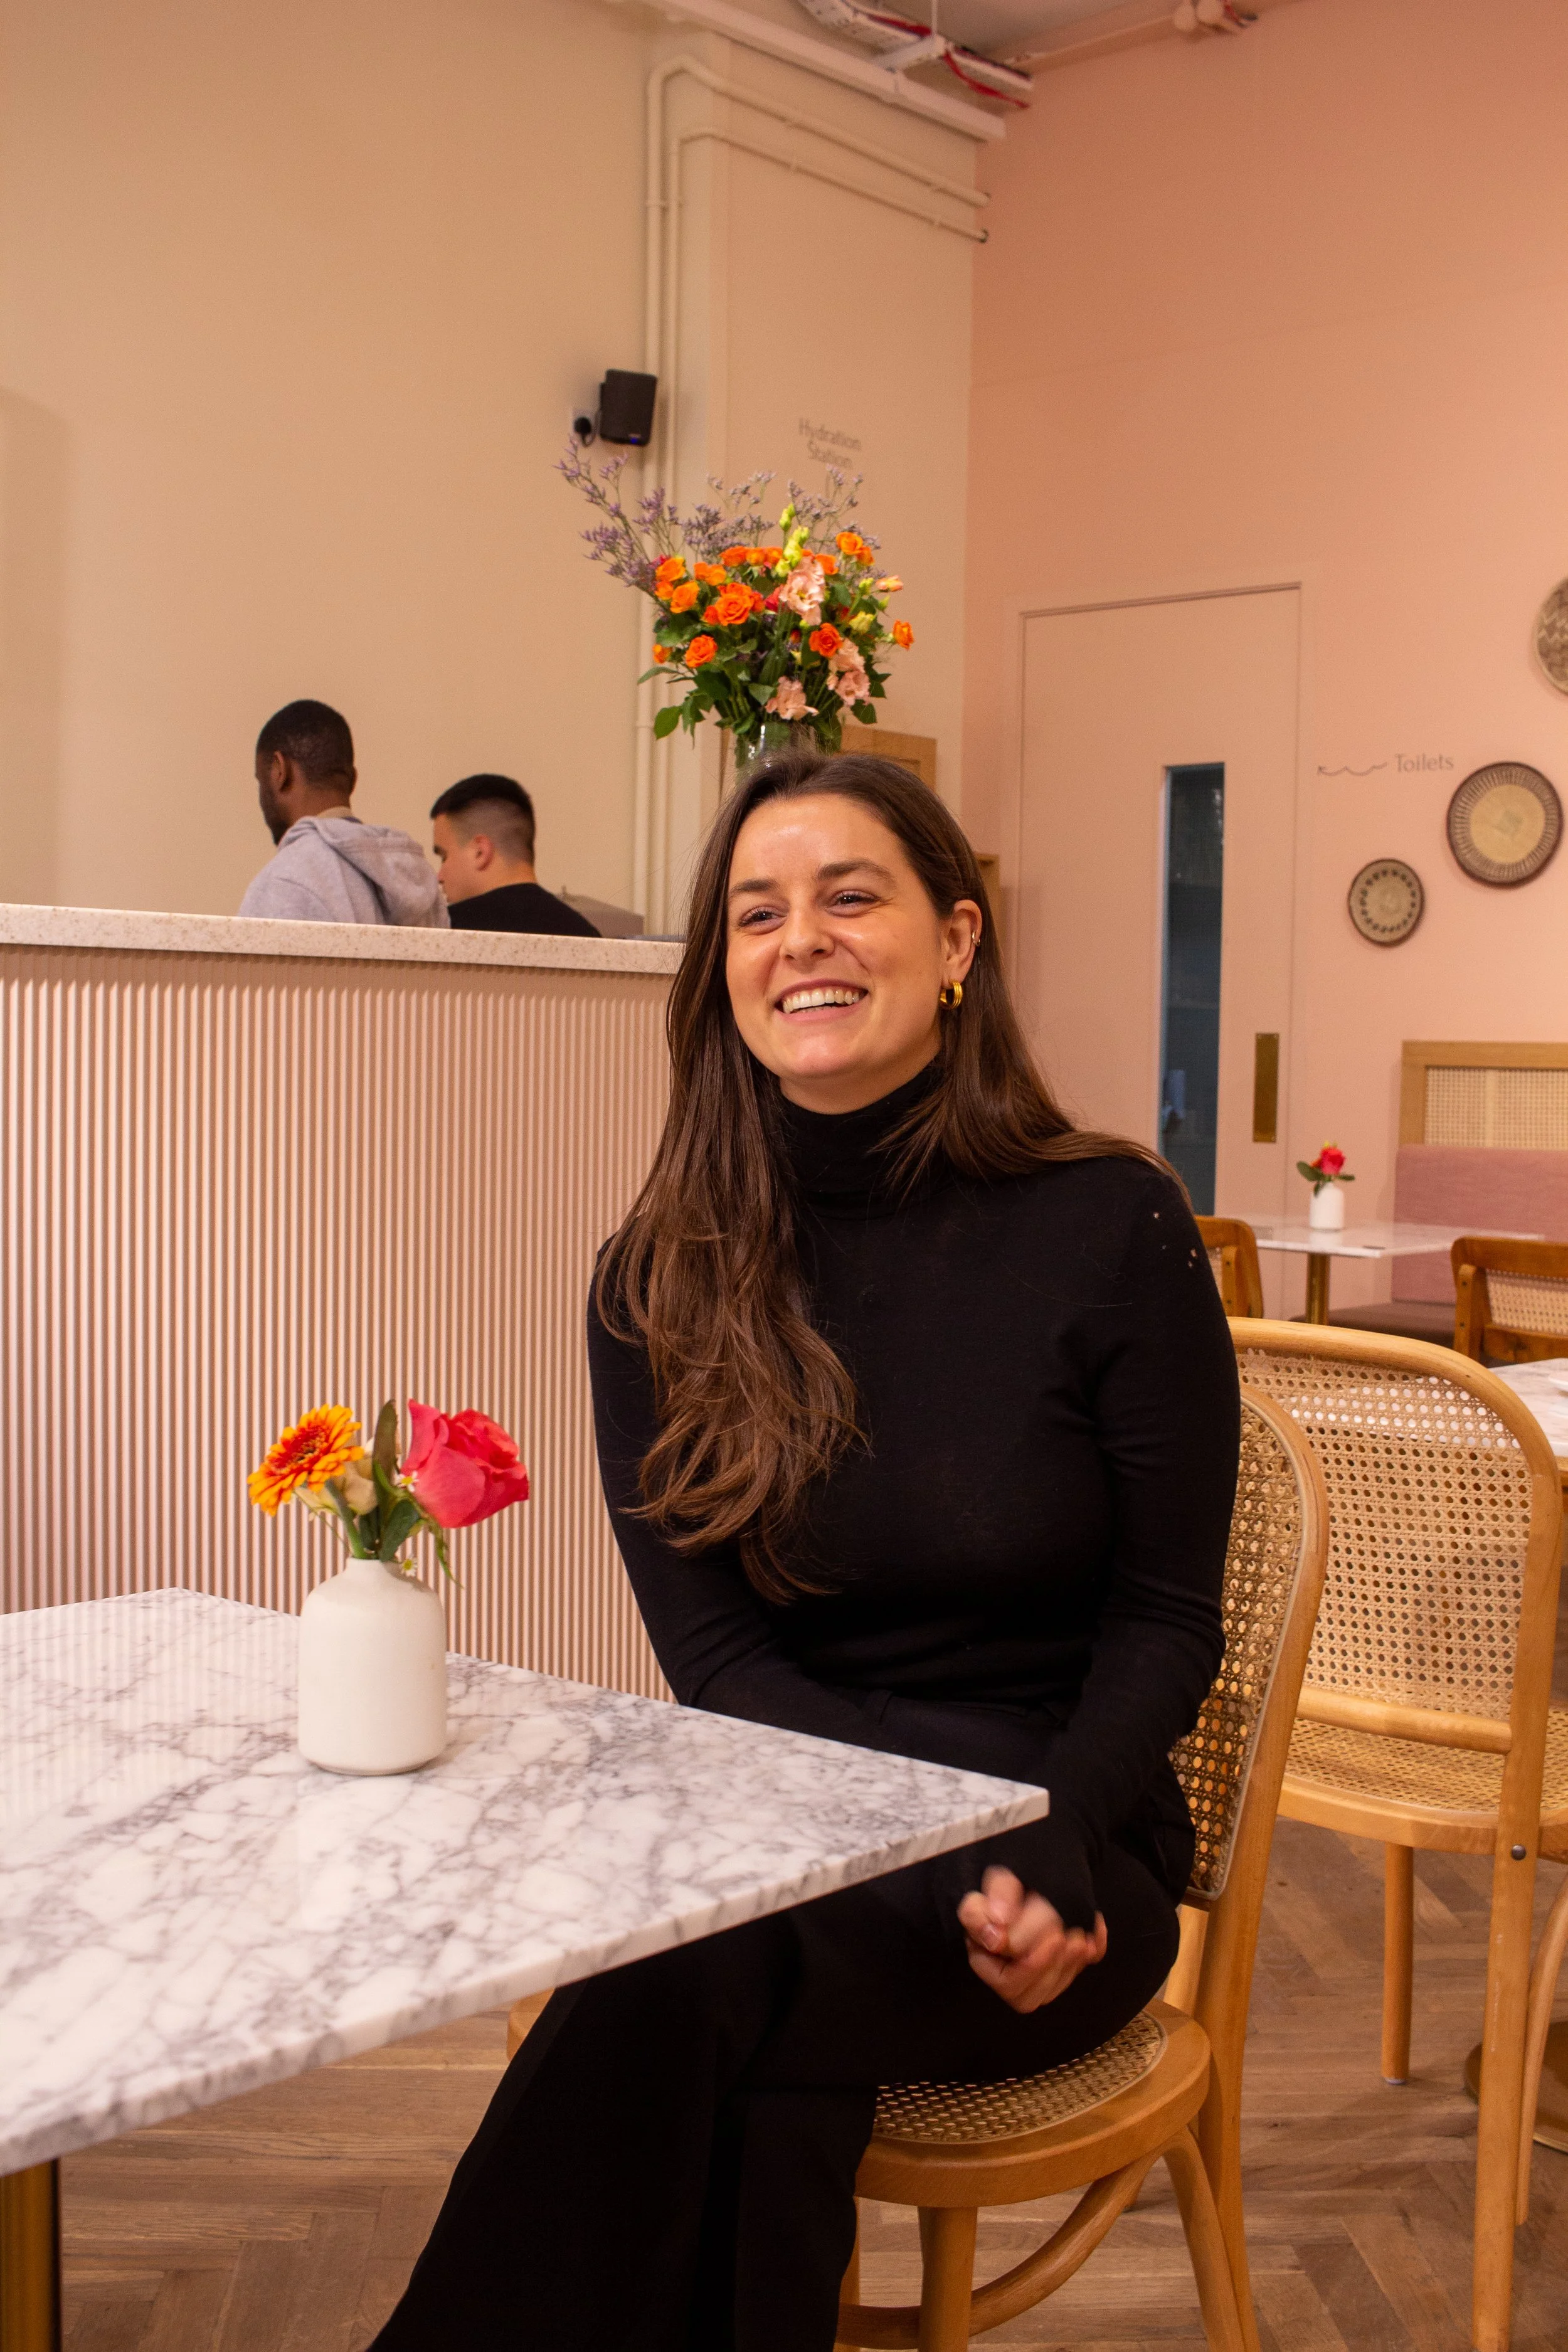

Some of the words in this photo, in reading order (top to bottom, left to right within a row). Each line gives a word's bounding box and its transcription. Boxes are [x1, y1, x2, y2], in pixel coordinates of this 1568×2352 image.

[798, 417, 862, 450] Hydration
[808, 440, 852, 469] Station
[1394, 753, 1454, 773] Toilets
